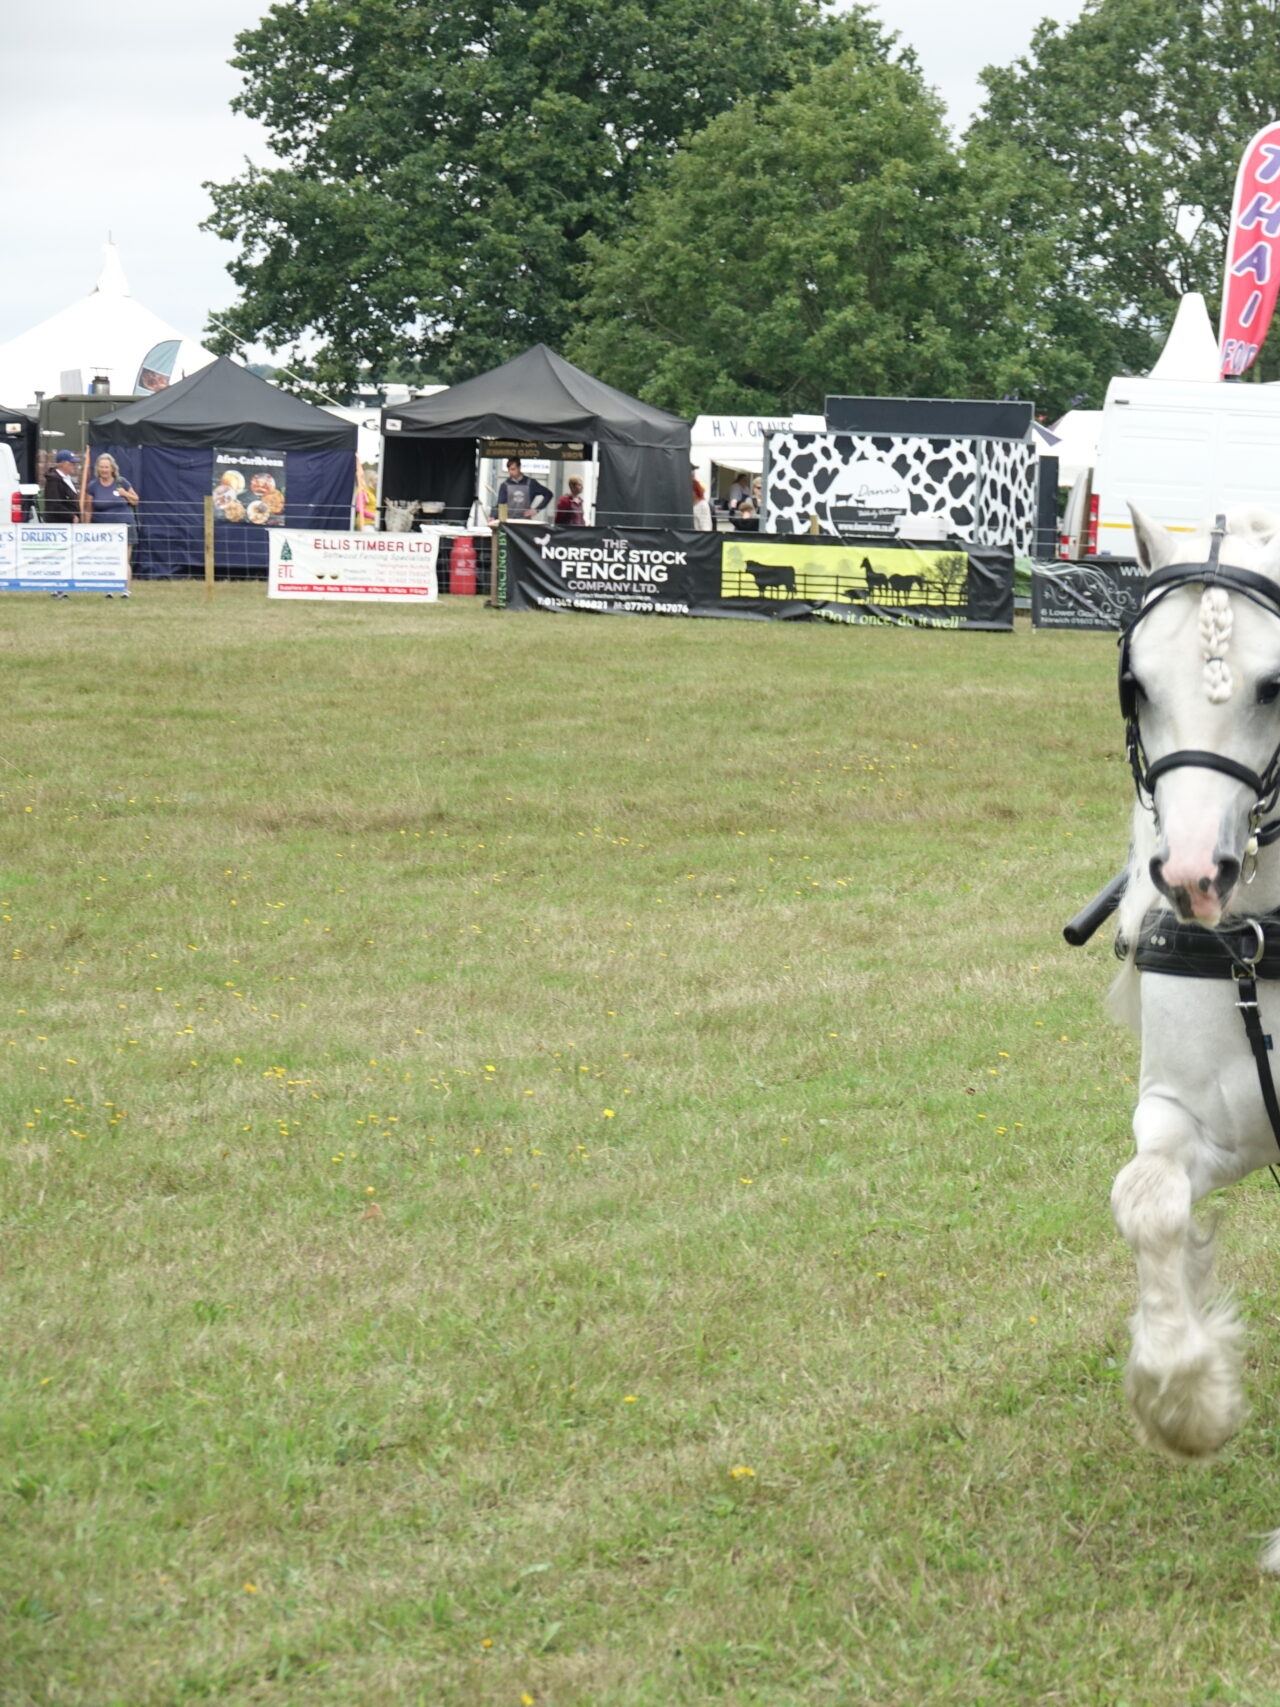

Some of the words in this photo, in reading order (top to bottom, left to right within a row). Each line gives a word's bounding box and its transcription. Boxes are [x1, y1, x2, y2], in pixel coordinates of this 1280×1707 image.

[216, 454, 284, 468] Afro-Caribbean
[21, 531, 68, 542] DRURY'S
[75, 532, 125, 542] DRURY'S
[602, 538, 629, 549] THE
[313, 538, 350, 551] ELLIS
[354, 540, 405, 552] TIMBER
[408, 542, 433, 553] LTD
[541, 546, 626, 562] NORFOLK
[628, 549, 687, 565] STOCK
[278, 564, 294, 578] ETL
[561, 561, 669, 582] FENCING
[567, 580, 631, 593] COMPANY
[632, 583, 660, 594] LTD.
[846, 610, 856, 624] it
[898, 613, 914, 626] do
[918, 614, 928, 627] it
